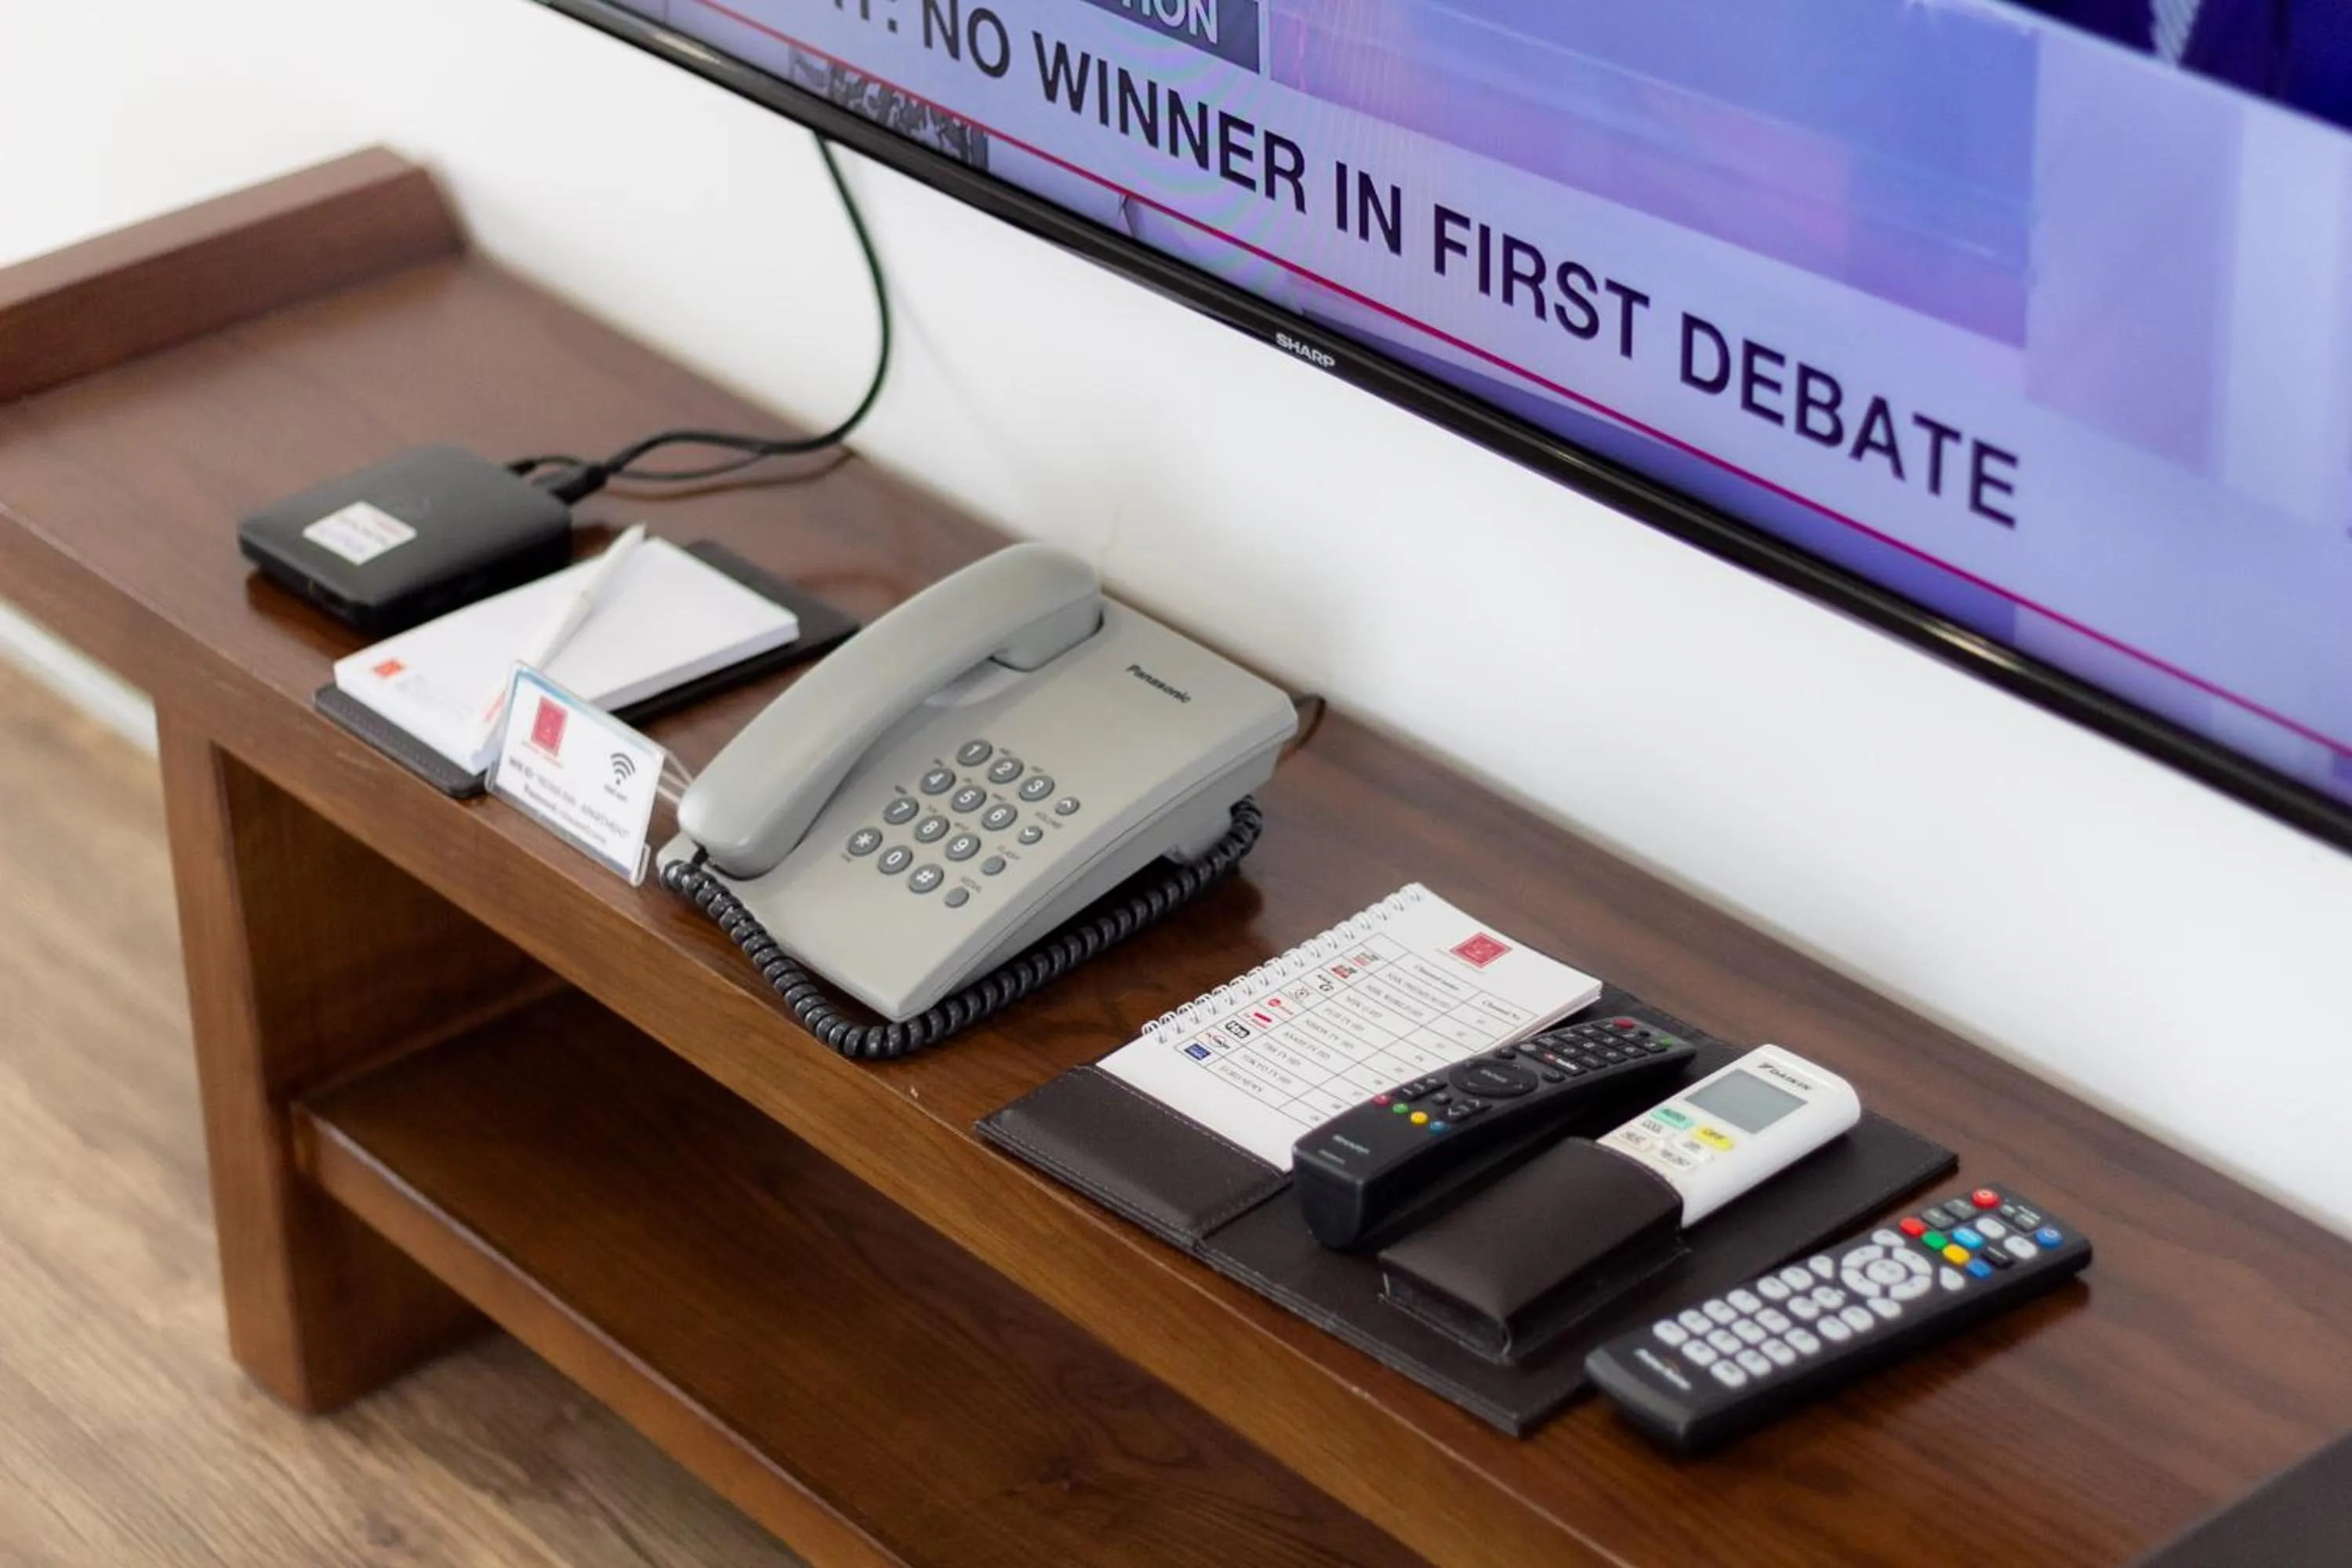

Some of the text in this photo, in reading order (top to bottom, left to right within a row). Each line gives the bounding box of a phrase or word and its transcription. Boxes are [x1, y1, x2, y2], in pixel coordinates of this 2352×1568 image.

[922, 0, 2019, 530] NO WINNER IN FIRST DEBATE
[1275, 332, 1336, 368] SHARP
[1126, 664, 1192, 703] Panasonic
[995, 761, 1014, 775] 2
[1027, 779, 1045, 793] 3
[958, 789, 977, 804] 5
[989, 808, 1007, 822] 6
[921, 819, 939, 834] 8
[952, 837, 970, 852] 9
